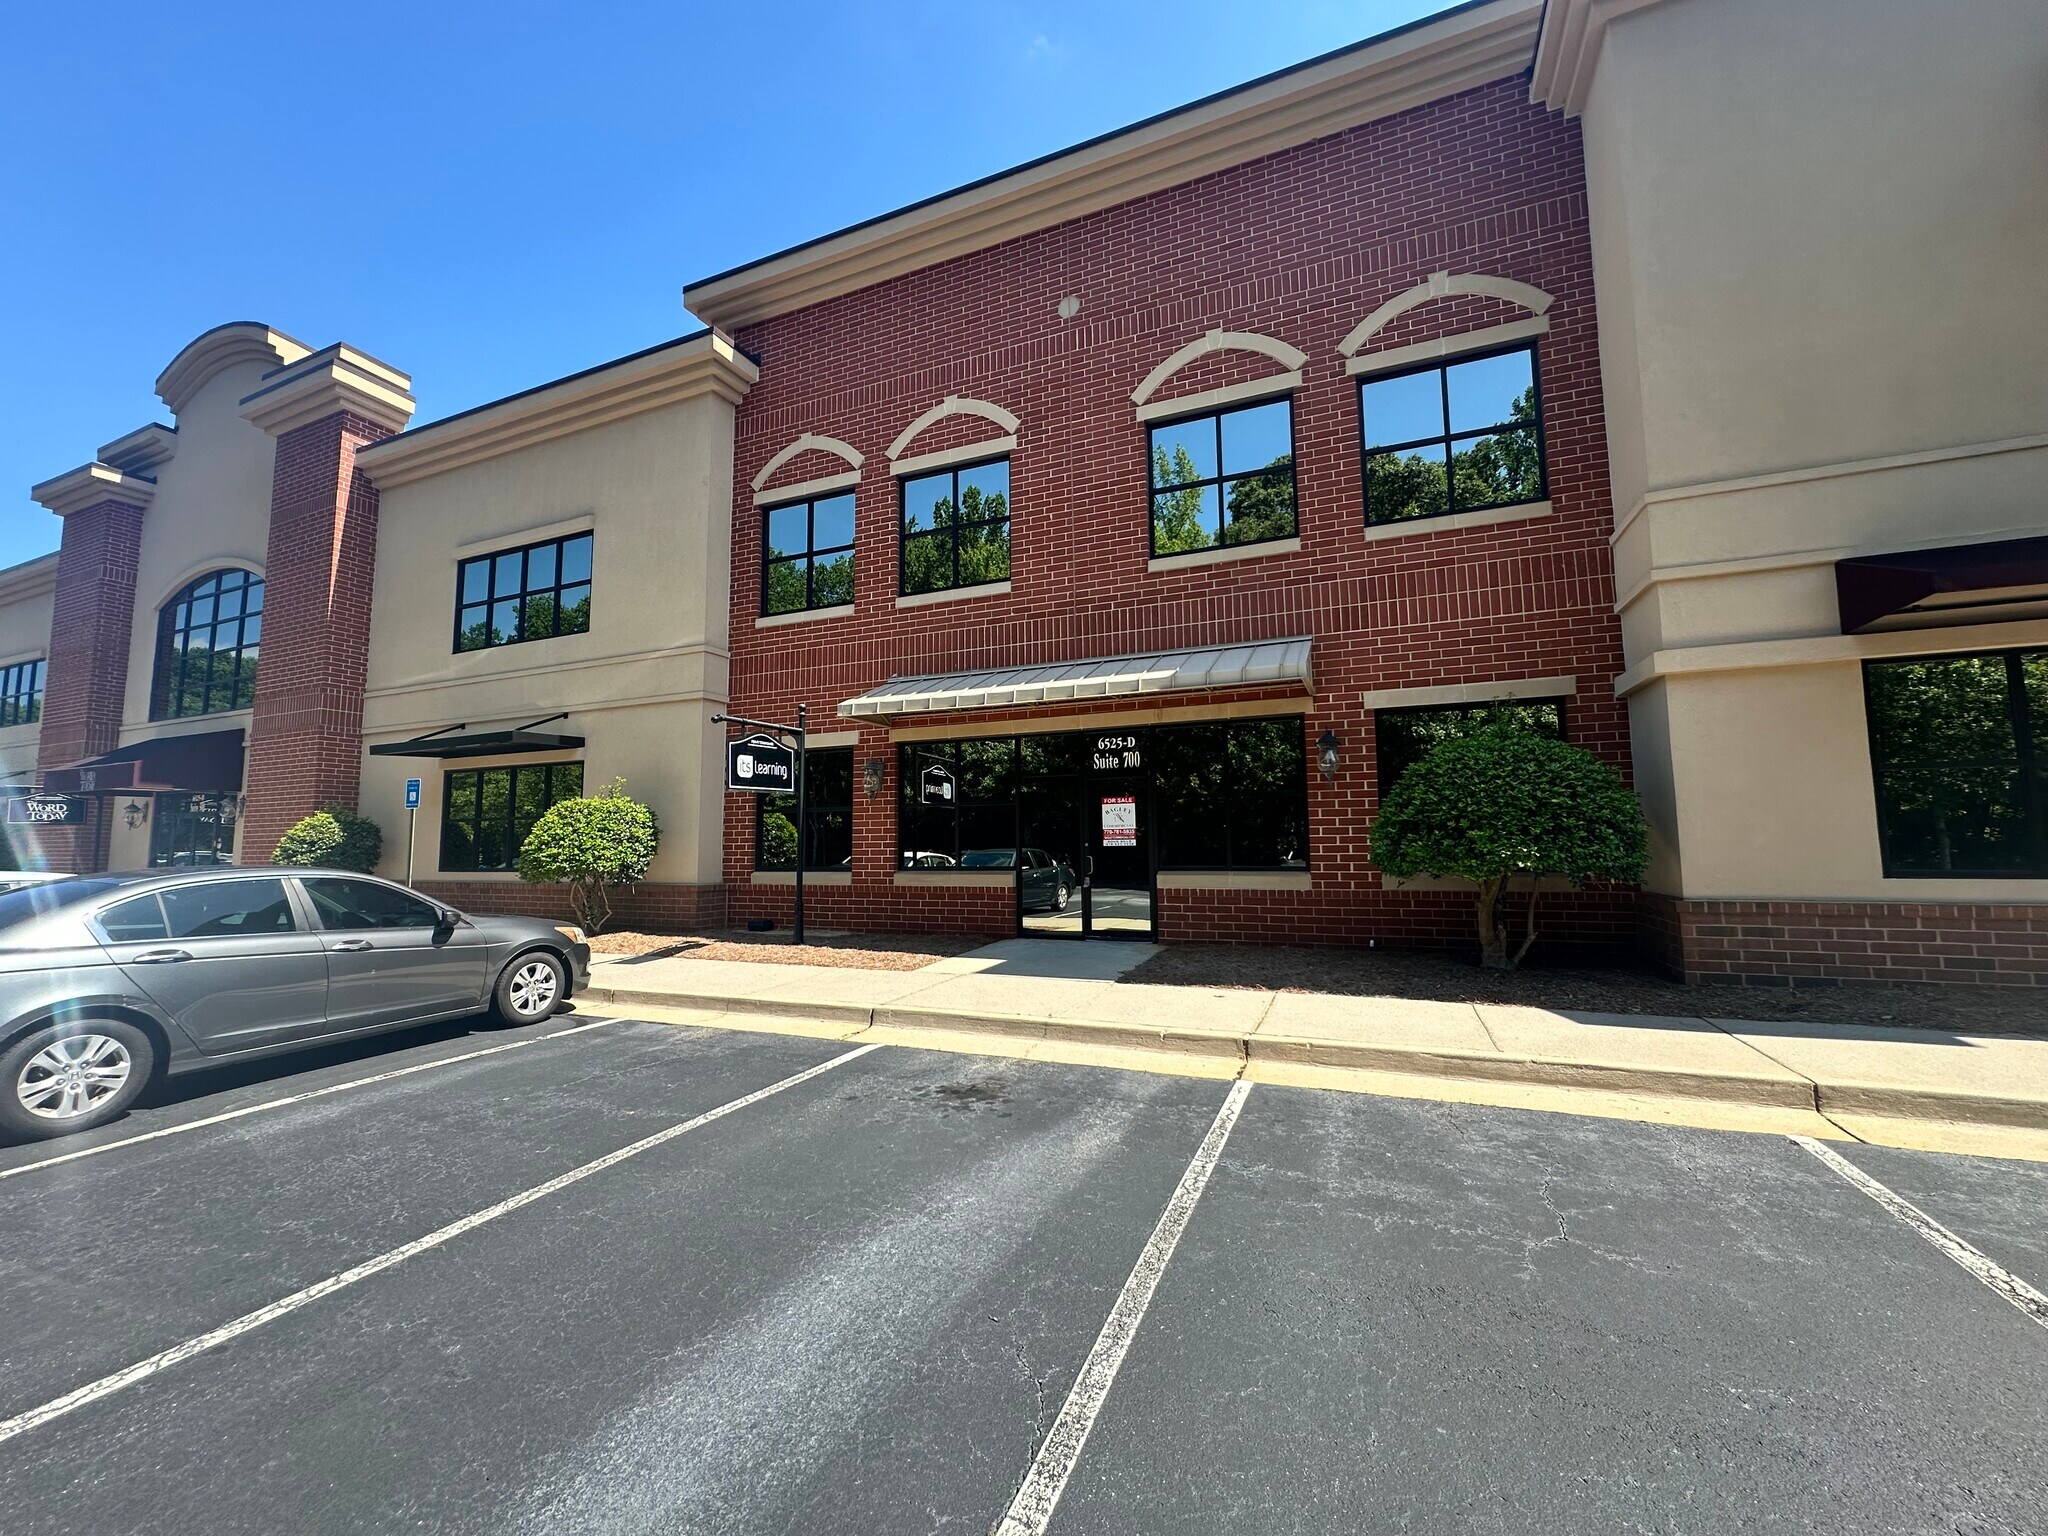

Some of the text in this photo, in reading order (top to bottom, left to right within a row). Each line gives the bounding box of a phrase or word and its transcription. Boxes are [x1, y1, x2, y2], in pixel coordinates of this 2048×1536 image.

[1098, 736, 1136, 750] 6525-D
[1093, 751, 1141, 769] Suite 700
